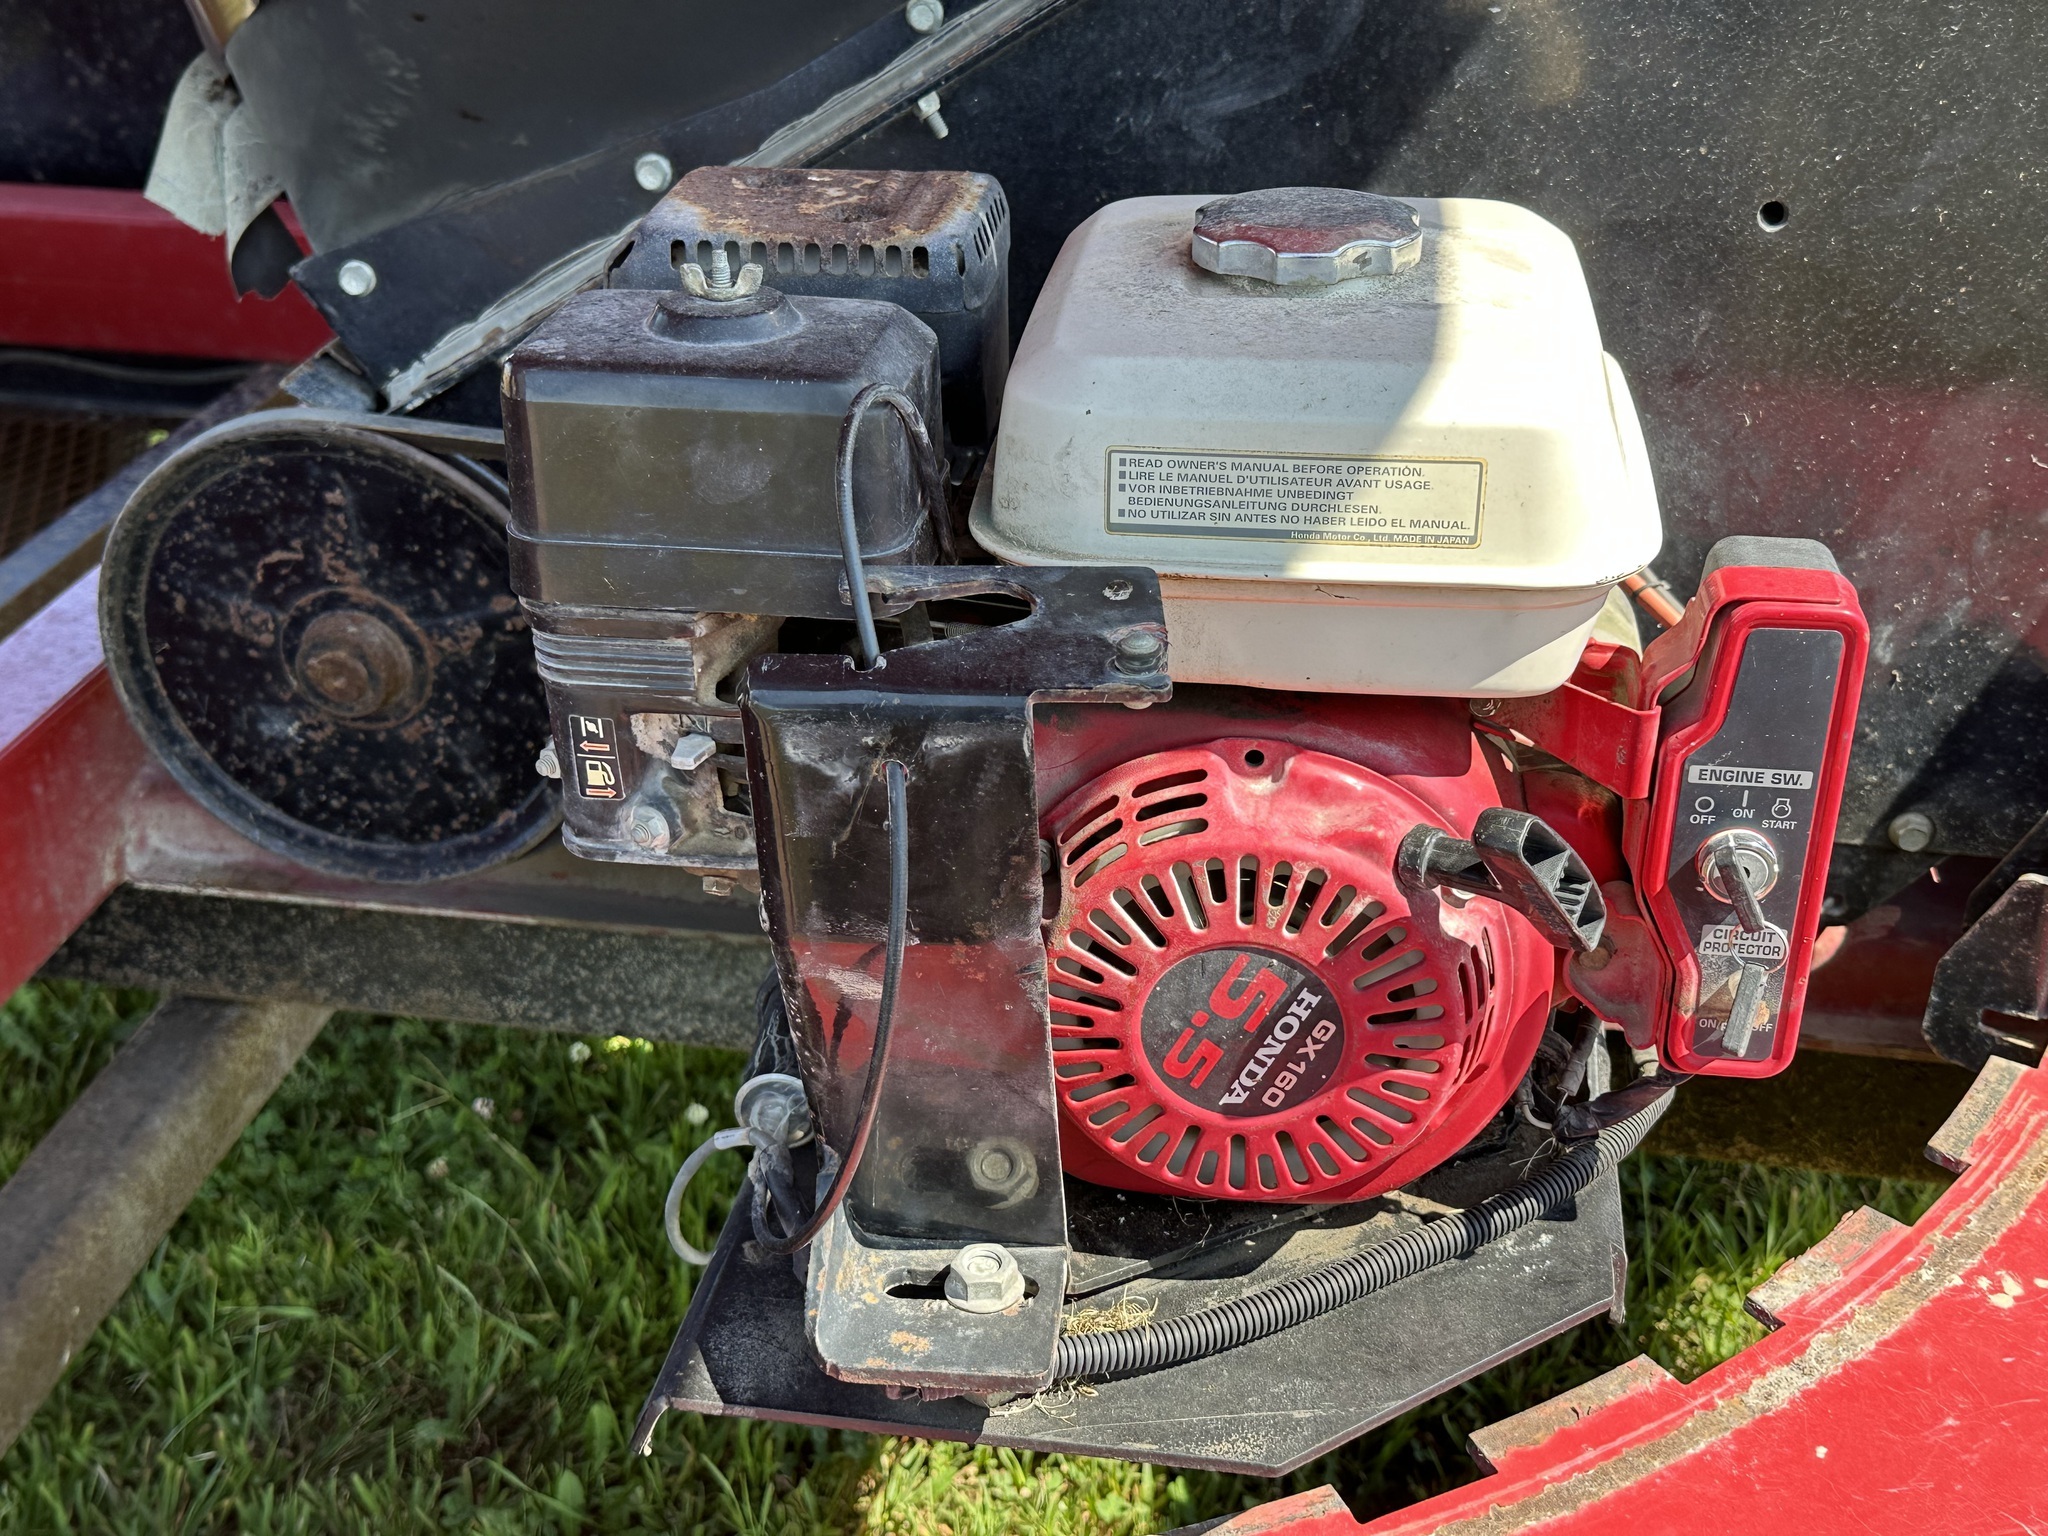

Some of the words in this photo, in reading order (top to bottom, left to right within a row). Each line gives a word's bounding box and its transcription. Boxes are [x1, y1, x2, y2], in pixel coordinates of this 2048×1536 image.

[1129, 458, 1163, 468] READ
[1167, 459, 1227, 470] OWNER'S
[1231, 461, 1289, 473] MANUAL
[1292, 463, 1342, 474] BEFORE
[1129, 470, 1155, 480] LIRE
[1159, 472, 1173, 482] LE
[1177, 473, 1233, 484] MANUEL
[1236, 474, 1332, 487] D'UTILISATEUR
[1336, 478, 1381, 489] AVANT
[1384, 480, 1434, 490] USAGE.
[1128, 483, 1155, 493] VOR
[1159, 485, 1273, 498] INBETRIEBNAHME
[1277, 489, 1354, 501] UNBEDINGT
[1128, 496, 1287, 511] BEDIENUNGSANLEITUNG
[1291, 502, 1382, 515] DURCHLESEN.
[1128, 509, 1147, 519] NO
[1150, 510, 1206, 521] UTILIZAR
[1209, 511, 1231, 522] SIN
[1234, 513, 1277, 524] ANTES
[1280, 515, 1300, 525] NO
[1303, 516, 1346, 526] HABER
[1350, 517, 1387, 527] LEIDO
[1391, 518, 1406, 528] EL
[1409, 519, 1471, 530] MANUAL.
[1290, 531, 1320, 540] Honda
[1323, 532, 1350, 541] Motor
[1373, 534, 1389, 542] Ltd.
[1393, 534, 1422, 543] MADE
[1424, 535, 1435, 544] IN
[1437, 536, 1470, 545] JAPAN
[1698, 768, 1765, 784] ENGINE
[1770, 772, 1803, 786] SW.
[1690, 814, 1716, 825] OFF
[1732, 808, 1755, 819] ON
[1762, 819, 1798, 830] START
[1713, 928, 1776, 943] CIRCUIT
[1703, 941, 1781, 957] PROTECTOR
[1162, 953, 1288, 1090] 5.5
[1218, 987, 1323, 1107] HONDA
